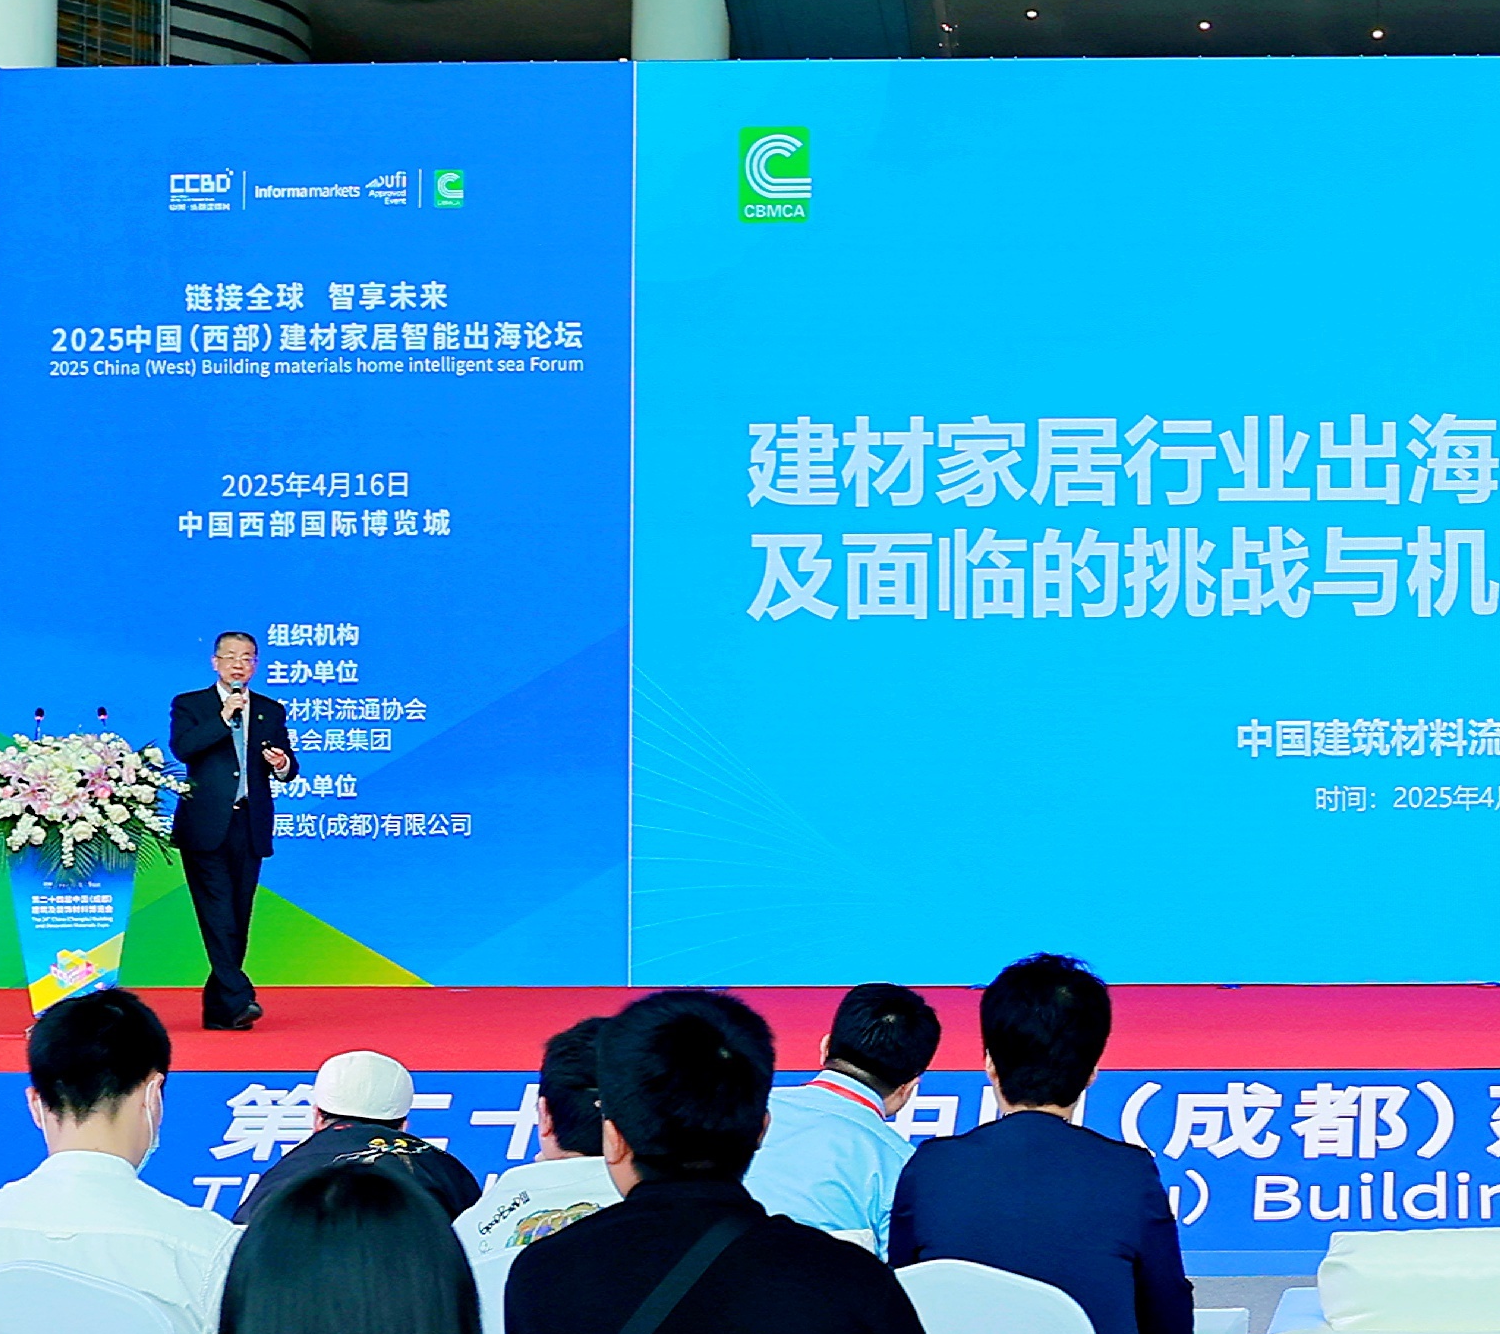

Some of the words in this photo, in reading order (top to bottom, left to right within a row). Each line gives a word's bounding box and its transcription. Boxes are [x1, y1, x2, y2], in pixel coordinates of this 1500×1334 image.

[744, 204, 806, 218] CBMCA
[184, 281, 304, 312] 链接全球
[328, 280, 448, 311] 智享未来
[50, 359, 90, 376] 2025
[93, 358, 140, 376] China
[145, 358, 197, 378] (West)
[201, 357, 271, 378] Building
[274, 357, 353, 374] materials
[356, 357, 405, 373] home
[408, 356, 494, 376] intelligent
[497, 359, 525, 373] sea
[529, 356, 584, 373] Forum
[222, 471, 409, 500] 2025年4月16日
[178, 508, 451, 539] 中国西部国际博览城
[267, 622, 360, 647] 组织机构
[266, 659, 360, 685] 主办单位
[278, 697, 428, 722] 材料流通协会
